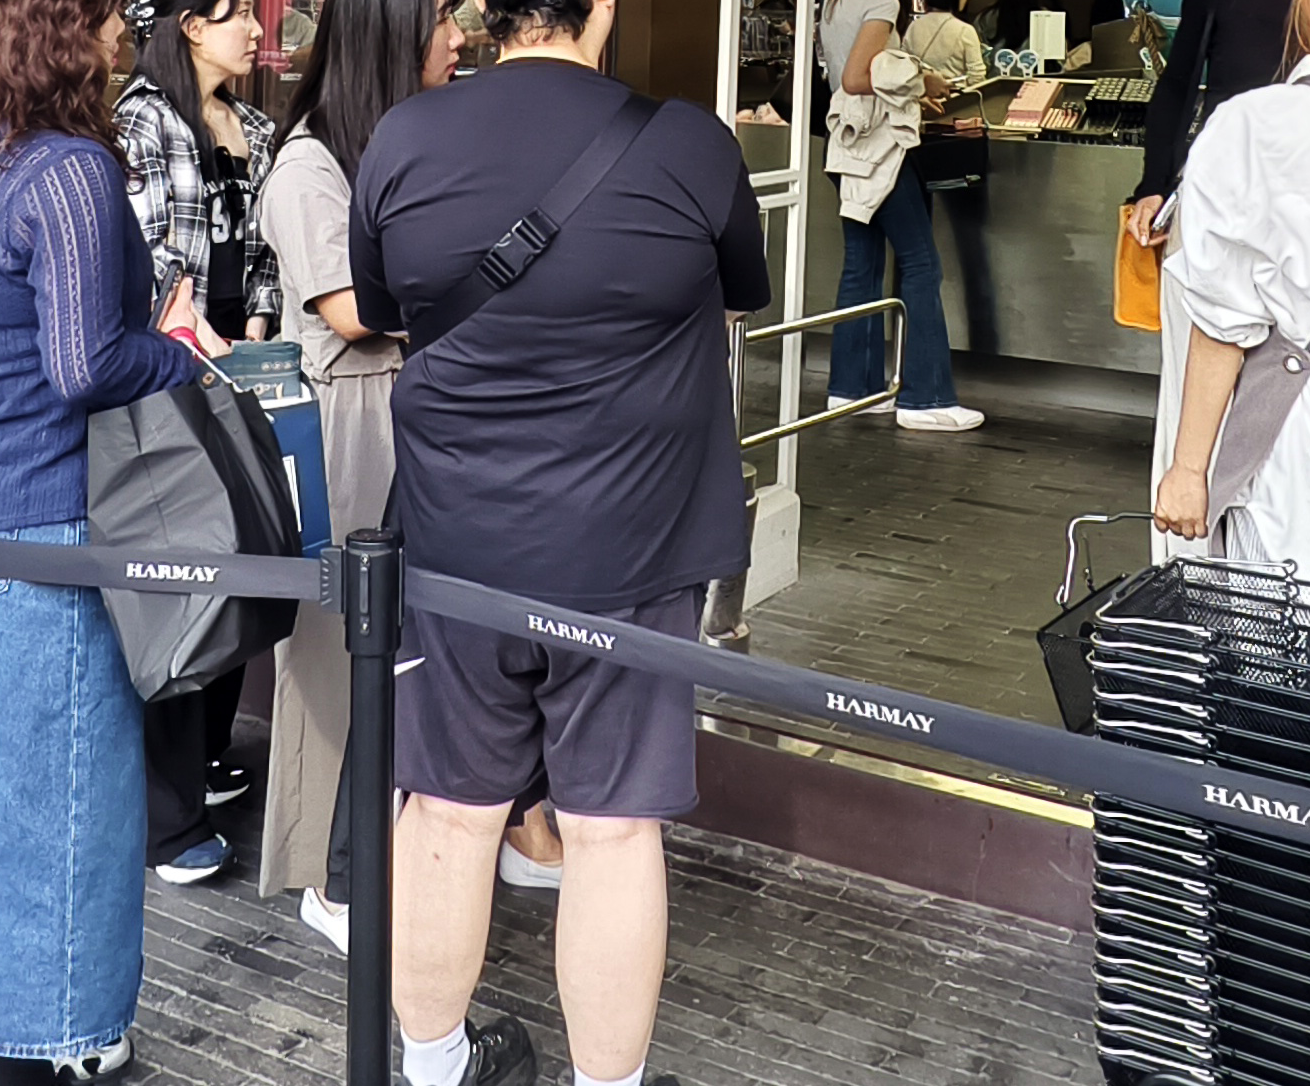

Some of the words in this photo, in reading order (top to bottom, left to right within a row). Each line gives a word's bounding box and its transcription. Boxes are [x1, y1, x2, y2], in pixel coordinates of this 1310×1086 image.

[125, 561, 219, 583] HARMAY
[527, 614, 615, 650] HARMAY
[826, 691, 935, 734] HARMAY
